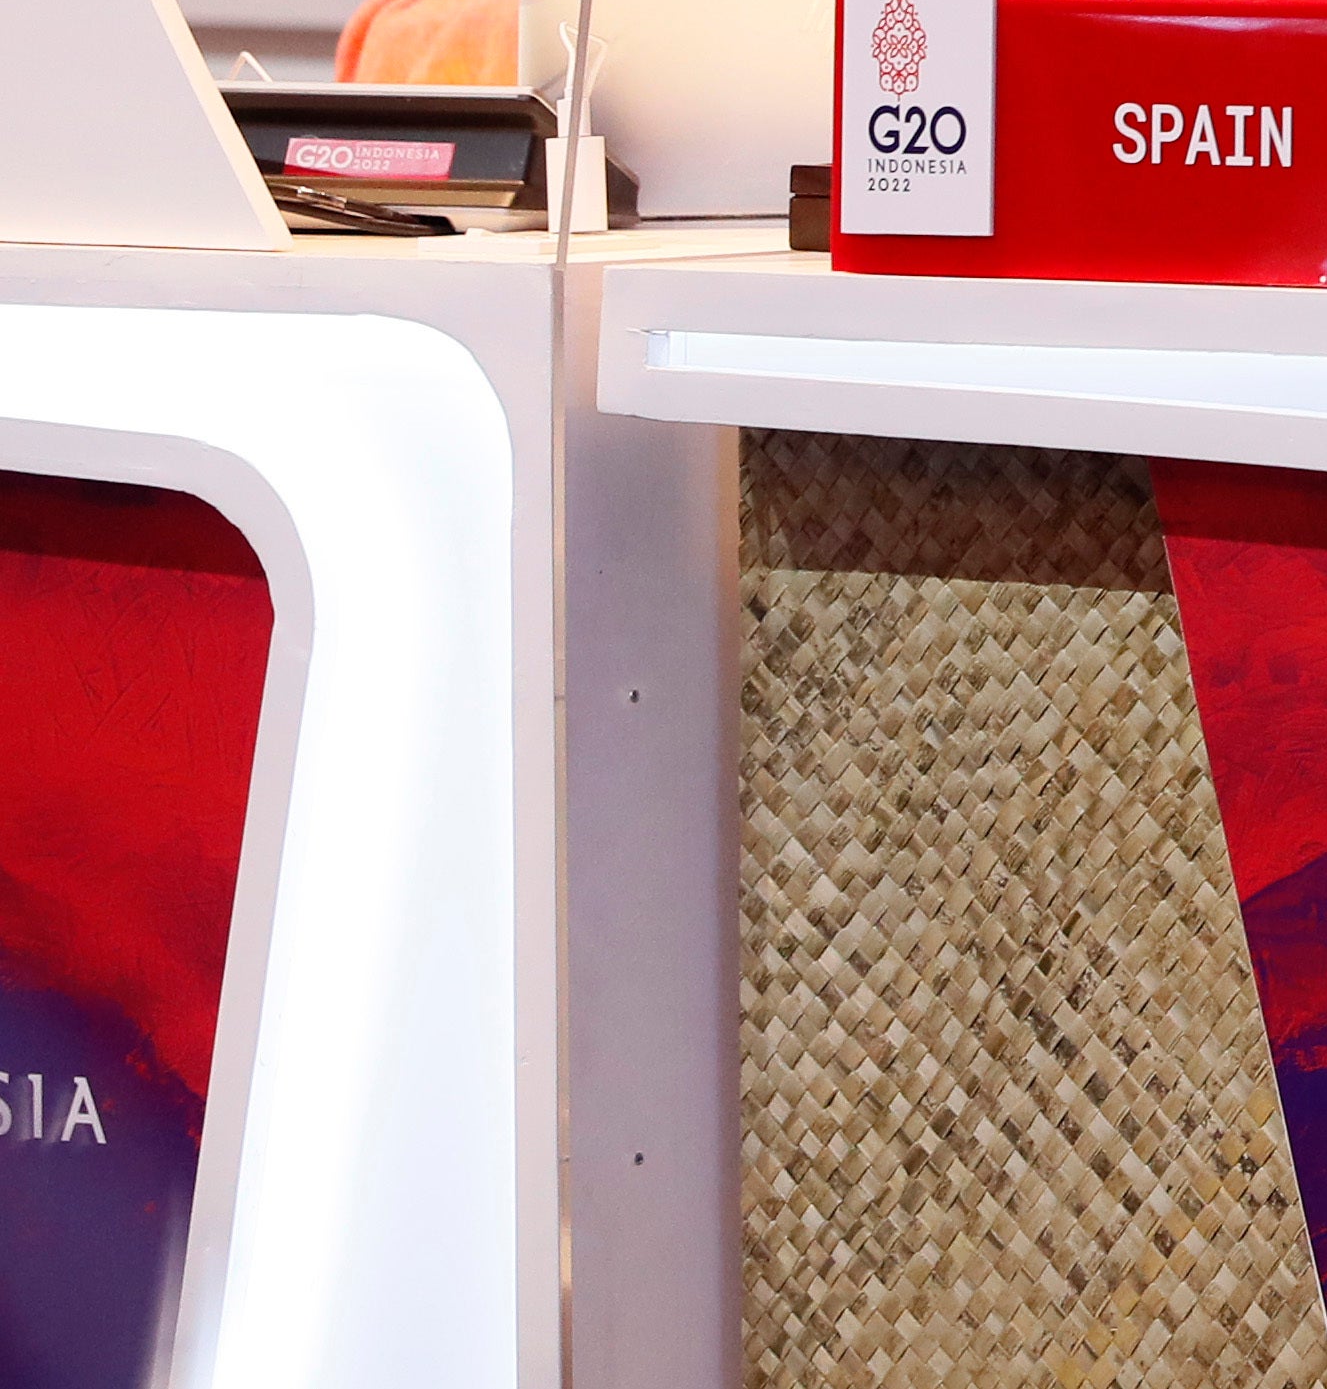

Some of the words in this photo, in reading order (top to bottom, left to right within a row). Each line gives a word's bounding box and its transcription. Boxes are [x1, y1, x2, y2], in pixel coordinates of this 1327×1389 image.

[867, 105, 967, 154] G20
[1112, 102, 1294, 168] SPAIN
[296, 144, 354, 169] G20
[355, 146, 441, 160] INDONESIA
[352, 158, 391, 171] 2022
[867, 158, 967, 175] INDONESIA
[867, 177, 912, 192] 2022
